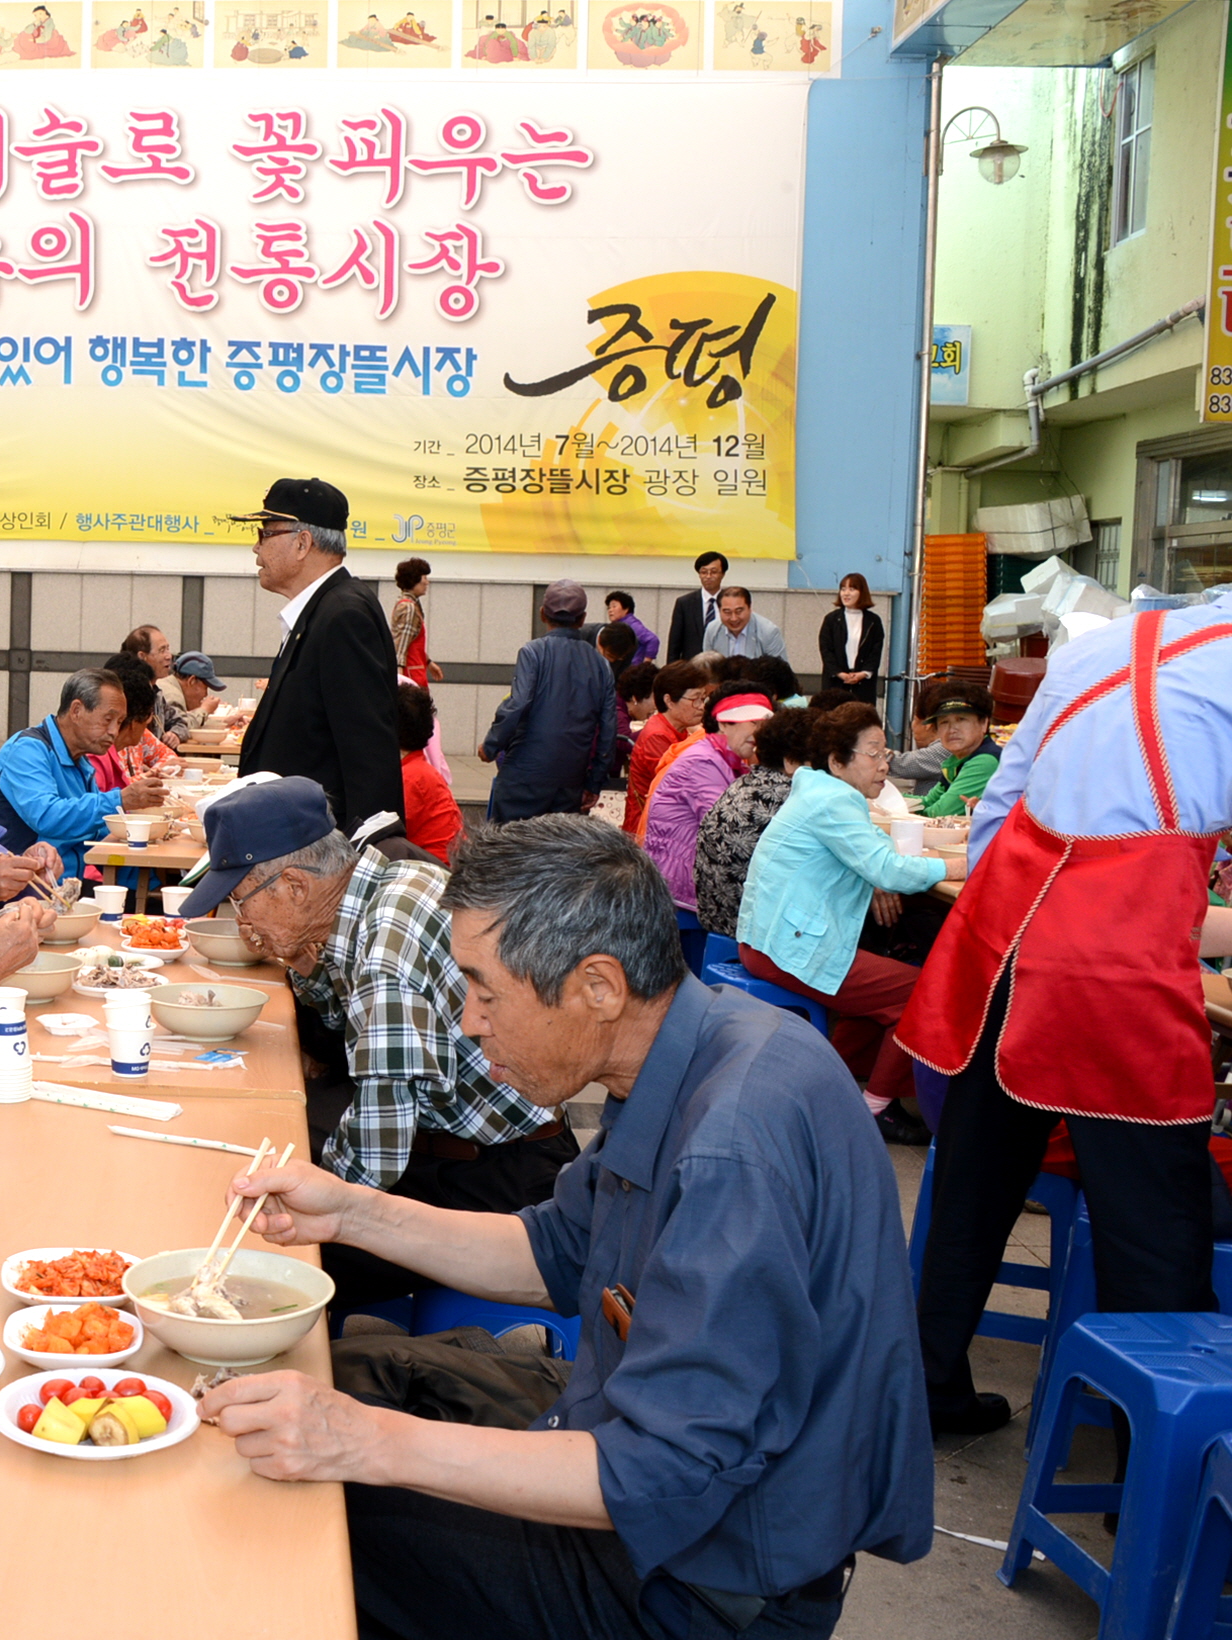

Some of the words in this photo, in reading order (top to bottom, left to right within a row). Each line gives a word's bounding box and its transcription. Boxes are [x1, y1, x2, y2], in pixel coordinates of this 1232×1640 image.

[231, 107, 590, 206] 꽃피우는
[149, 217, 501, 317] 전통시장
[88, 335, 212, 388] 행복한
[225, 340, 478, 398] 증평장뜰시장
[503, 292, 777, 409] 증평
[413, 440, 442, 455] 기간
[464, 432, 542, 458] 2014년
[712, 432, 766, 460] 12월
[412, 475, 442, 490] 장소
[463, 467, 631, 496] 증평장뜰시장
[643, 468, 700, 497] 광장
[713, 468, 767, 497] 일원
[75, 512, 200, 533] 행사주관대행사
[426, 522, 456, 539] 증평군
